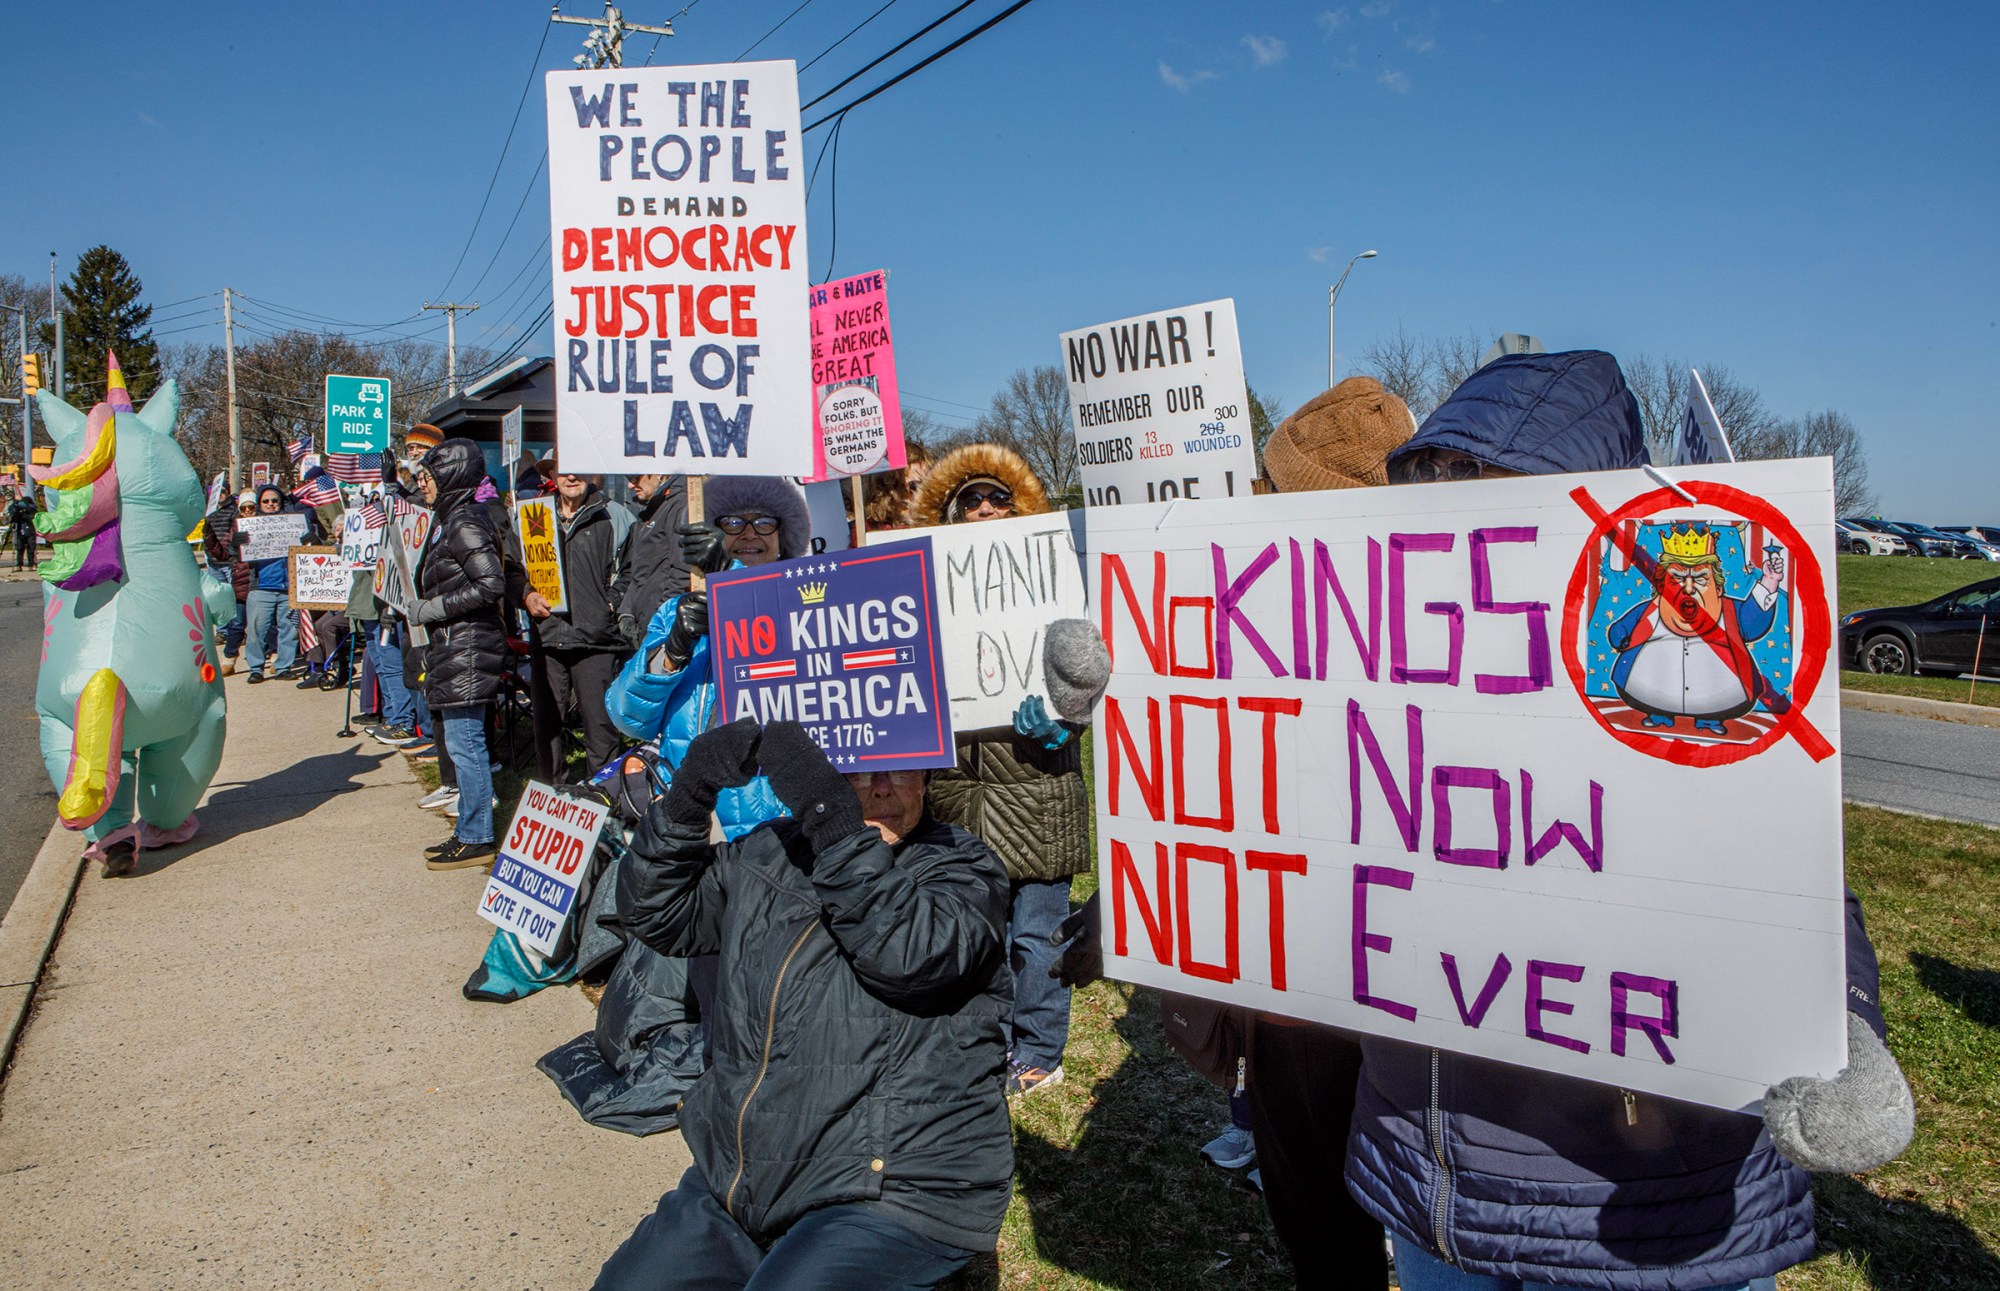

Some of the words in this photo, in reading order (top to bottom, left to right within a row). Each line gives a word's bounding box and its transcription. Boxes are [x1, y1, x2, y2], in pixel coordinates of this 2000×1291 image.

[569, 82, 643, 128] WE
[668, 79, 751, 128] THE
[599, 130, 790, 183] PEOPLE
[617, 196, 748, 218] DEMAND
[562, 224, 796, 272] DEMOCRACY
[809, 289, 828, 309] AR
[844, 274, 883, 298] HATE
[564, 284, 758, 339] JUSTICE
[810, 320, 824, 339] LL
[835, 301, 884, 331] NEVER
[811, 343, 824, 360] KE
[832, 326, 889, 355] AMERICA
[1068, 332, 1107, 384] NO
[1110, 316, 1192, 373] WAR
[568, 339, 674, 394] RULE
[689, 343, 760, 396] OF
[812, 352, 875, 384] GREAT
[332, 405, 366, 418] PARK
[373, 407, 393, 419] &
[833, 397, 865, 411] SORRY
[860, 406, 878, 417] BUT
[1079, 393, 1152, 427] REMEMBER
[1166, 385, 1205, 414] OUR
[1214, 405, 1238, 421] 300
[342, 422, 373, 435] RIDE
[623, 400, 754, 458] LAW
[821, 419, 870, 436] IGNORING
[872, 417, 881, 426] IT
[824, 437, 833, 446] IS
[835, 431, 863, 443] WHAT
[865, 428, 884, 438] THE
[1145, 431, 1158, 444] 13
[830, 440, 877, 456] GERMANS
[846, 454, 867, 464] DID.
[1079, 437, 1133, 466] SOLDIERS
[1139, 443, 1174, 460] KILLED
[1184, 434, 1241, 454] WOUNDED
[345, 515, 361, 532] NO
[298, 555, 310, 566] We
[342, 545, 361, 561] FOR
[535, 541, 557, 563] KINGS
[303, 576, 324, 586] RALLY
[320, 569, 334, 578] NOT
[310, 588, 347, 598] INTERVENT
[1211, 525, 1553, 695] KINGS
[724, 615, 776, 659] NO
[789, 595, 919, 651] KINGS
[806, 652, 832, 677] IN
[735, 672, 928, 726] AMERICA
[1105, 693, 1303, 836] NOT
[526, 788, 549, 811] YOU
[546, 797, 579, 823] CAN'T
[576, 809, 599, 832] FIX
[509, 815, 584, 876] STUPID
[498, 859, 521, 884] BUT
[519, 868, 542, 896] YOU
[539, 880, 565, 908] CAN
[516, 906, 532, 930] IT
[529, 914, 556, 943] OUT
[1110, 838, 1308, 992] NOT
